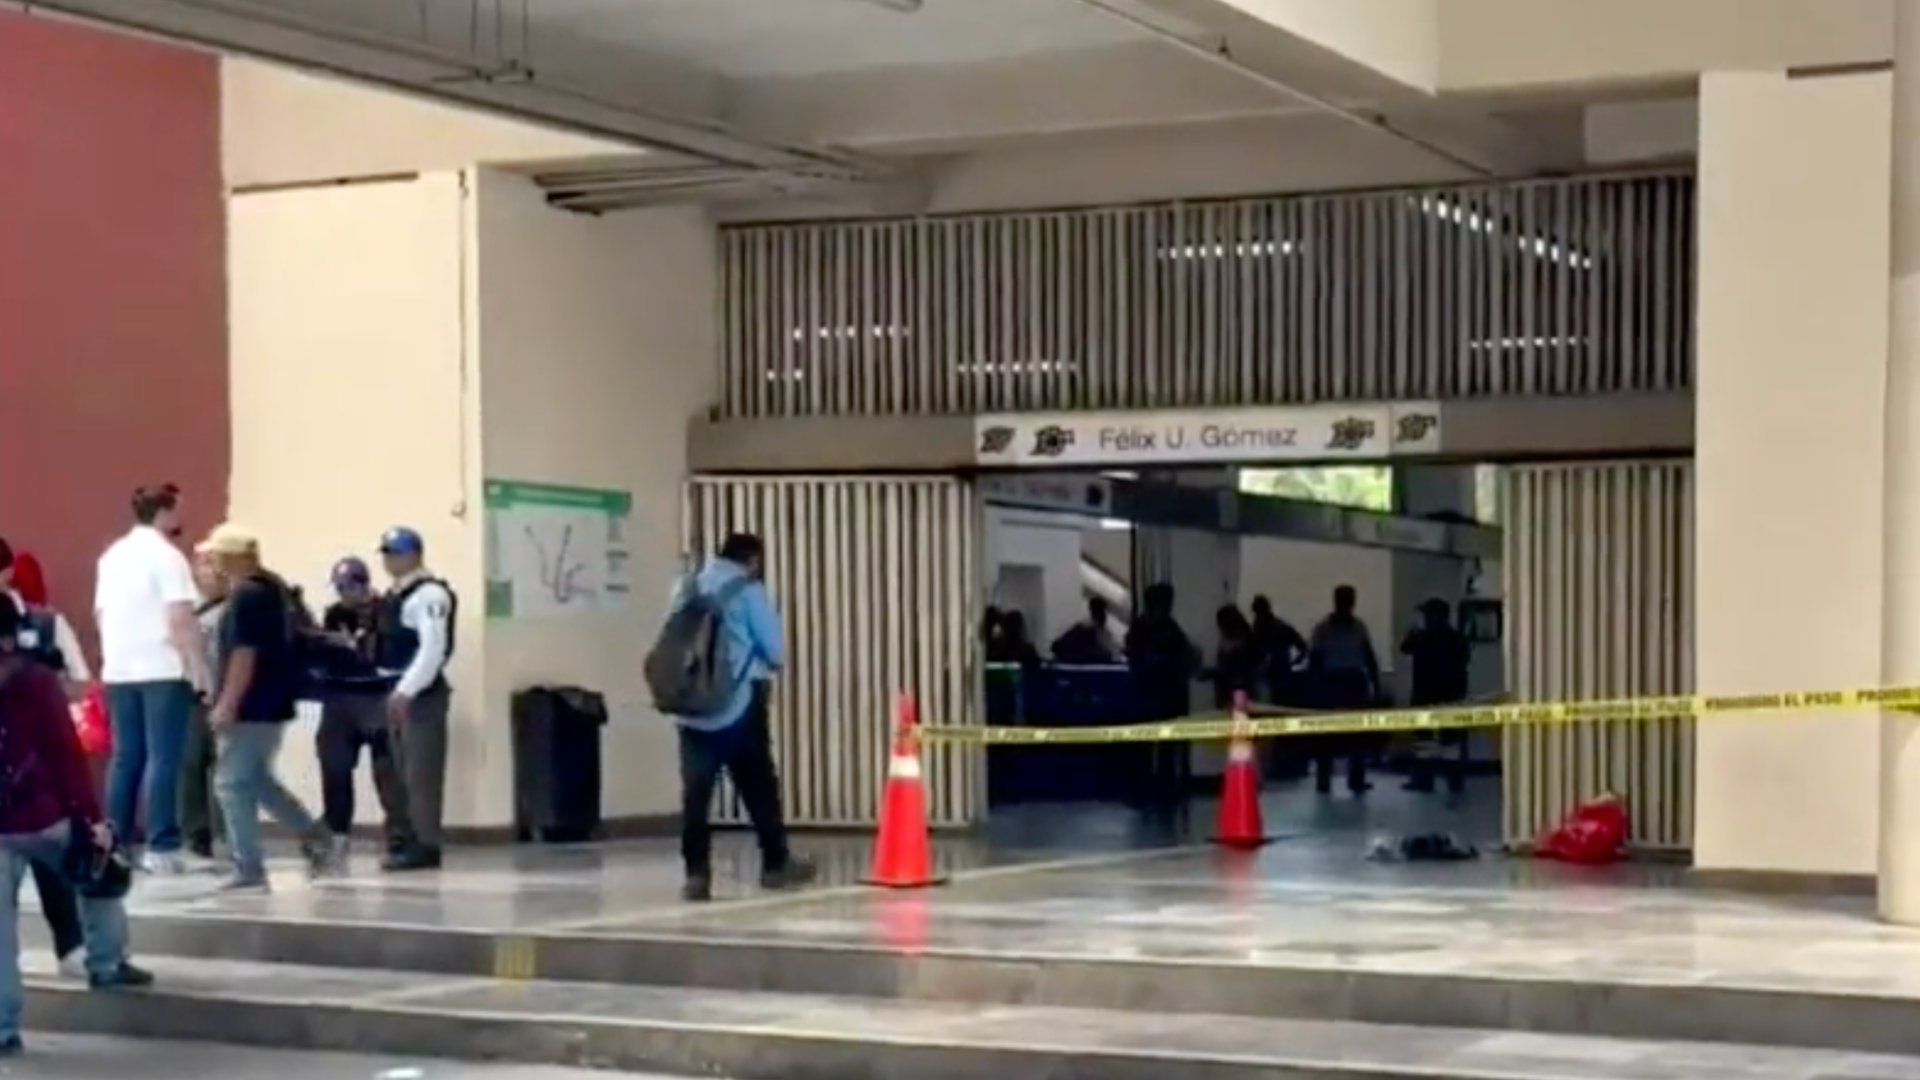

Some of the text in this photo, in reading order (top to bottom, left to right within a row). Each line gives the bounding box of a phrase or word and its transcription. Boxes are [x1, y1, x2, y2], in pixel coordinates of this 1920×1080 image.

[1099, 423, 1297, 450] Félix U. Gómez
[1804, 691, 1843, 705] PASO
